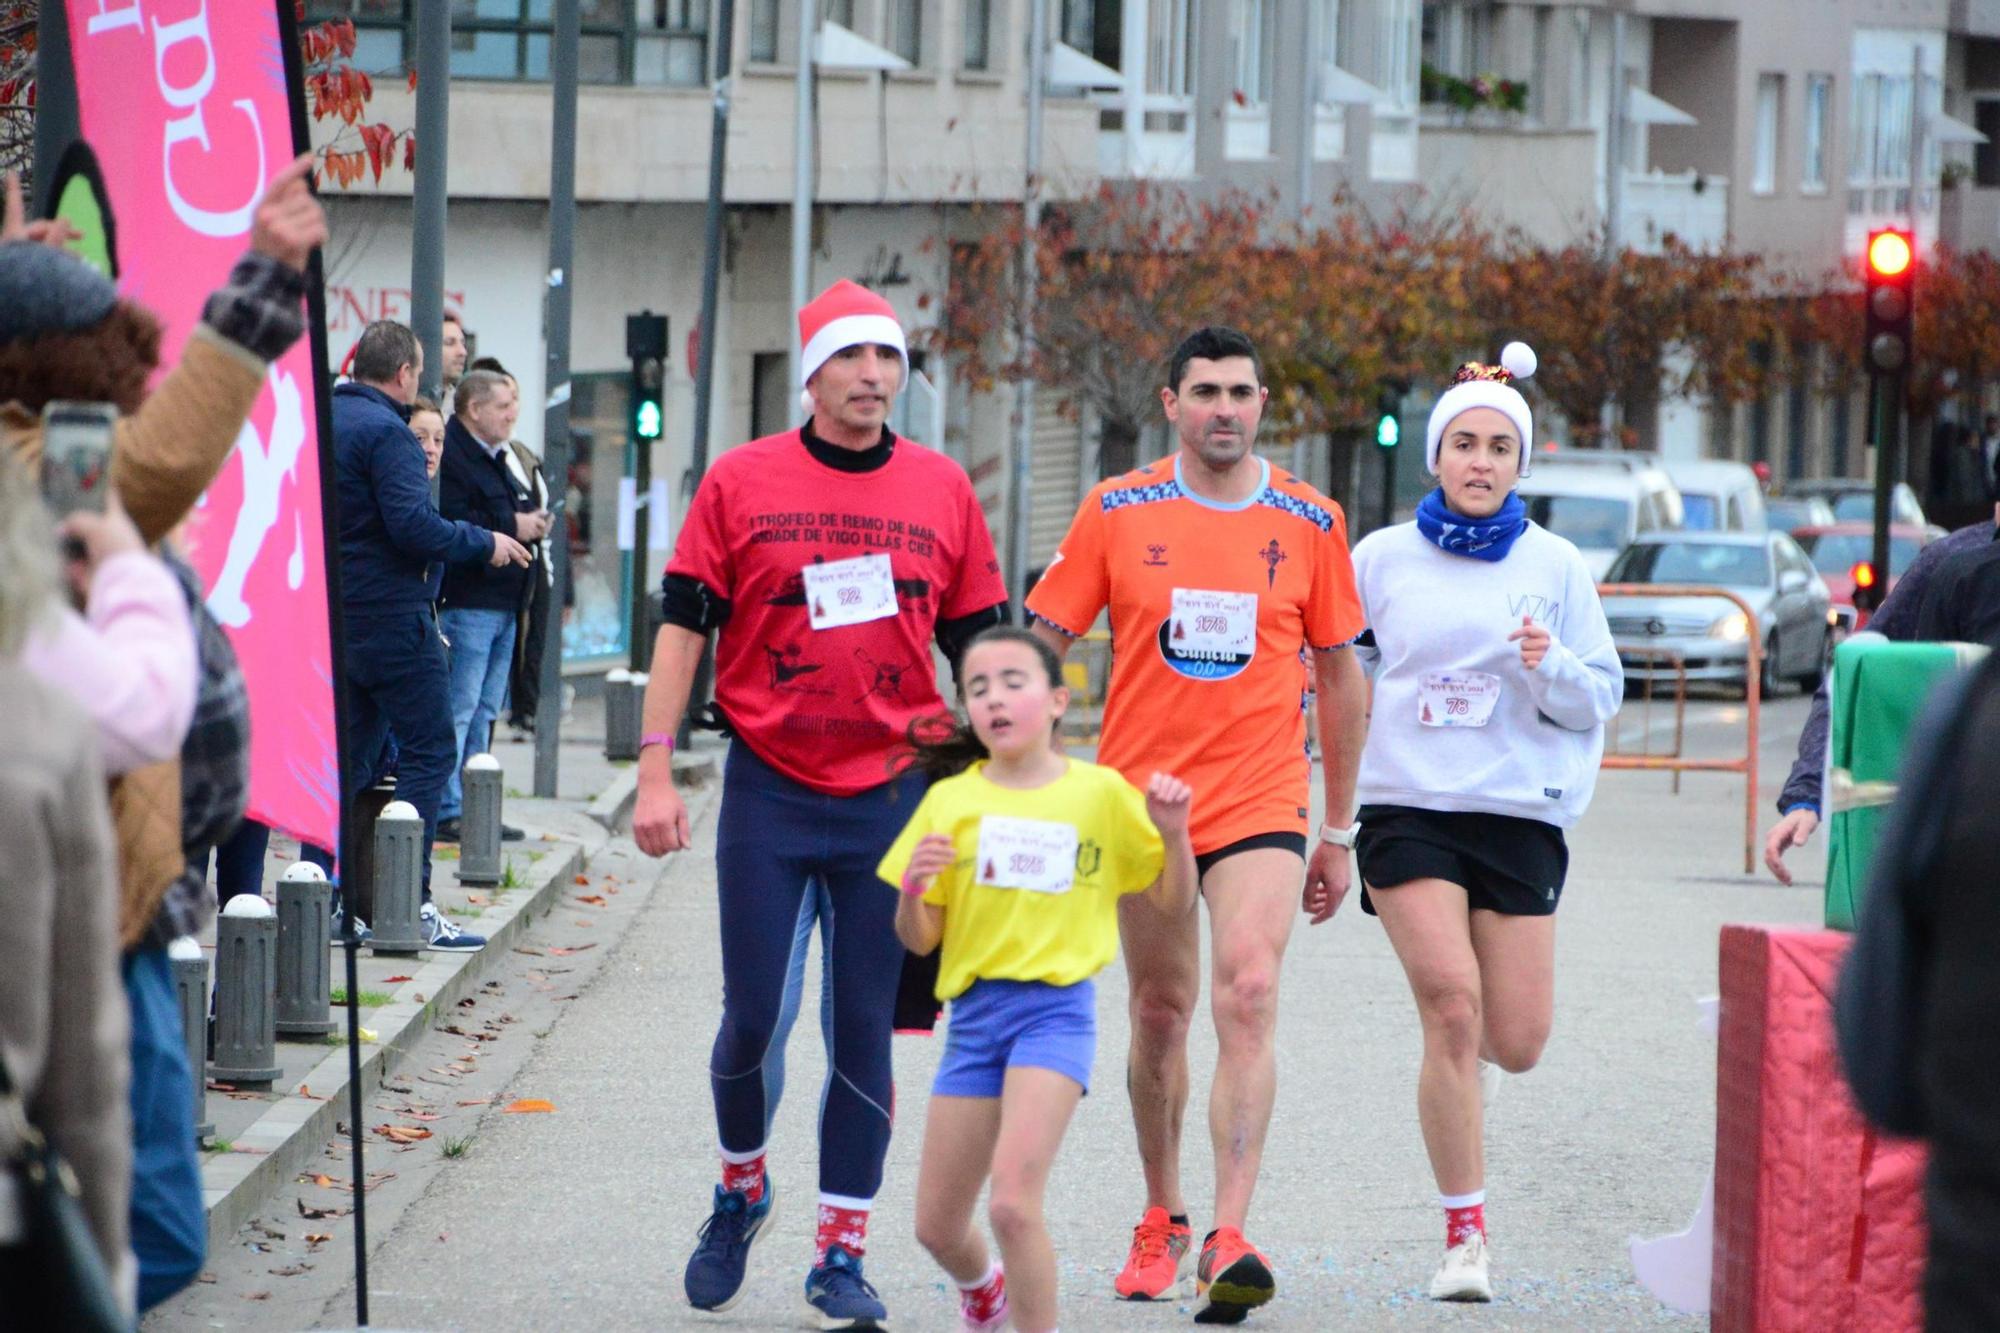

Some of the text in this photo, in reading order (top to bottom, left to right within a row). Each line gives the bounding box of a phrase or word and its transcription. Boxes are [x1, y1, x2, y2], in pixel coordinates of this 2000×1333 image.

[758, 513, 815, 527] TROFEO
[820, 513, 837, 526] DE
[842, 514, 883, 531] REMO
[888, 520, 904, 533] DE
[804, 529, 821, 542] DE
[827, 530, 860, 545] VIGO
[837, 586, 862, 606] 92
[1195, 615, 1228, 634] 178
[1446, 698, 1469, 715] 78
